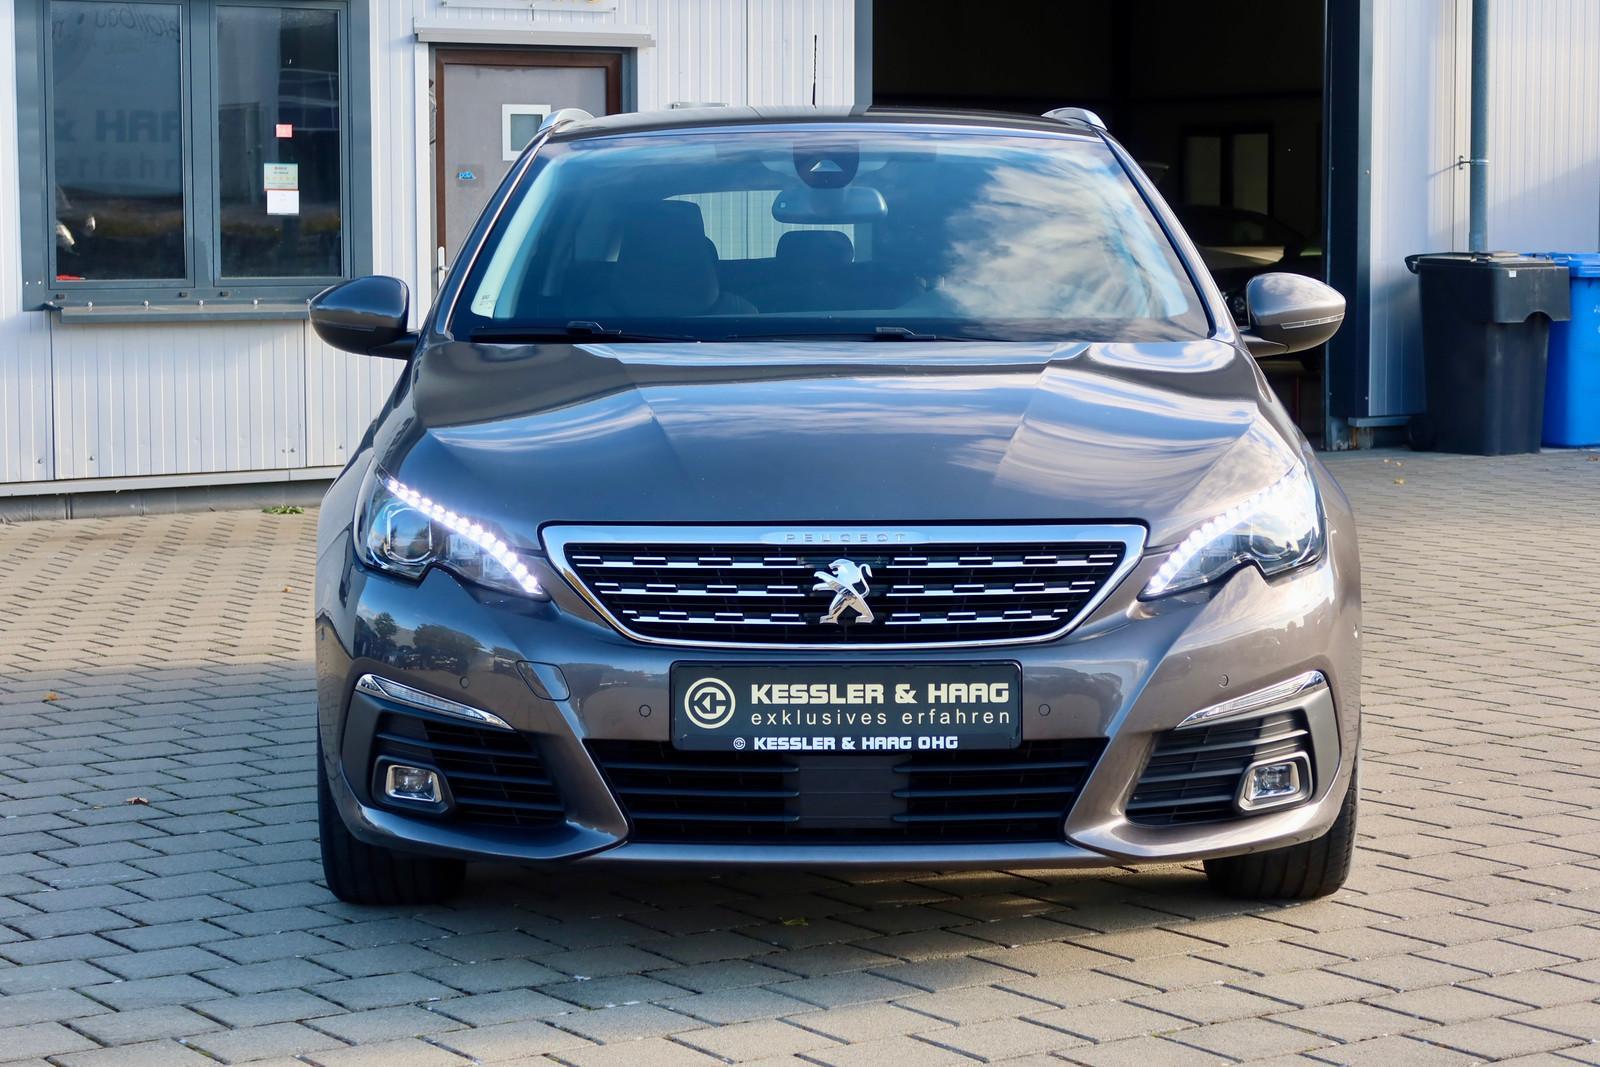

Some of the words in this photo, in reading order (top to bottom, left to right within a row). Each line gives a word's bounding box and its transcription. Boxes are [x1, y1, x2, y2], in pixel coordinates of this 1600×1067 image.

[785, 533, 905, 543] PEUGEOT
[751, 683, 885, 705] KESSLER
[895, 683, 918, 704] &
[927, 682, 1010, 704] HAAG
[751, 709, 887, 726] exklusives
[902, 708, 1010, 725] erfahren
[754, 736, 836, 750] KESSLER
[841, 736, 856, 750] &
[861, 736, 913, 750] HAAG
[917, 735, 959, 750] OHG
